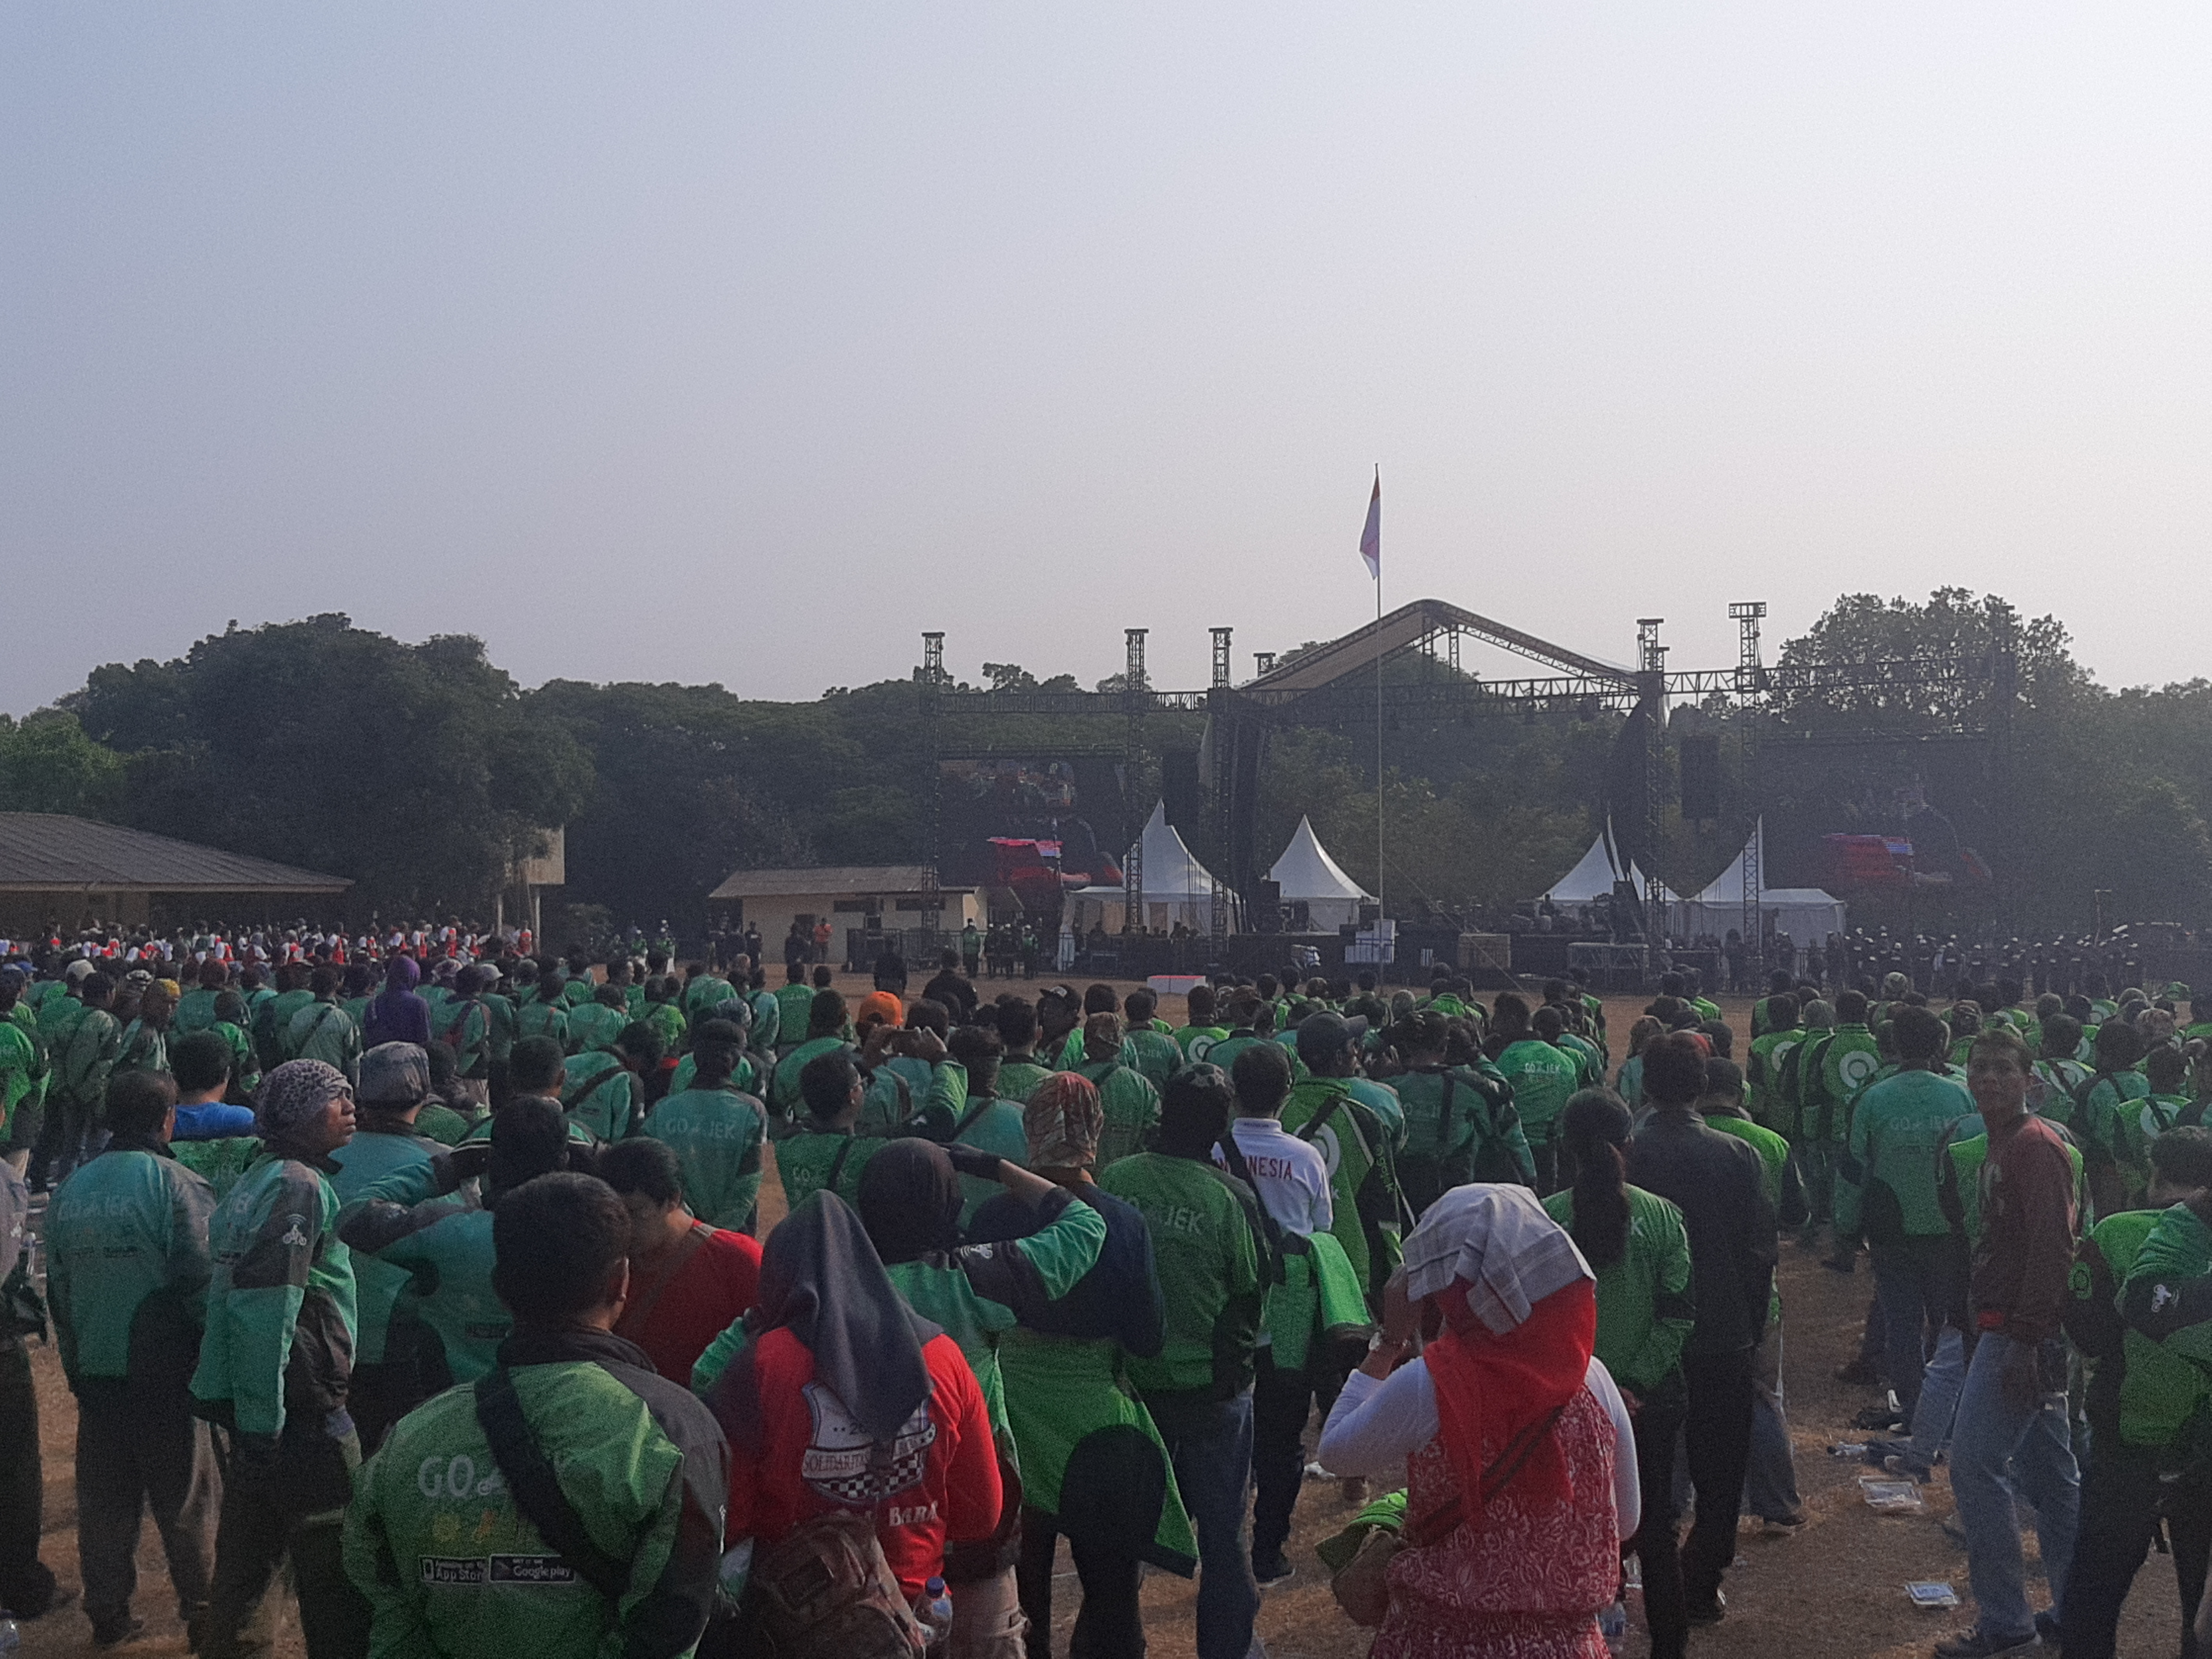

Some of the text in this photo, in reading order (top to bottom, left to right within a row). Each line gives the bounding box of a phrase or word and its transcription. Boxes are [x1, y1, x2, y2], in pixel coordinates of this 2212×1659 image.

[665, 1118, 736, 1140] GO JEK
[1164, 1205, 1205, 1236] JEK
[419, 1455, 474, 1497] GO
[436, 1569, 456, 1582] App
[513, 1565, 570, 1579] Google play
